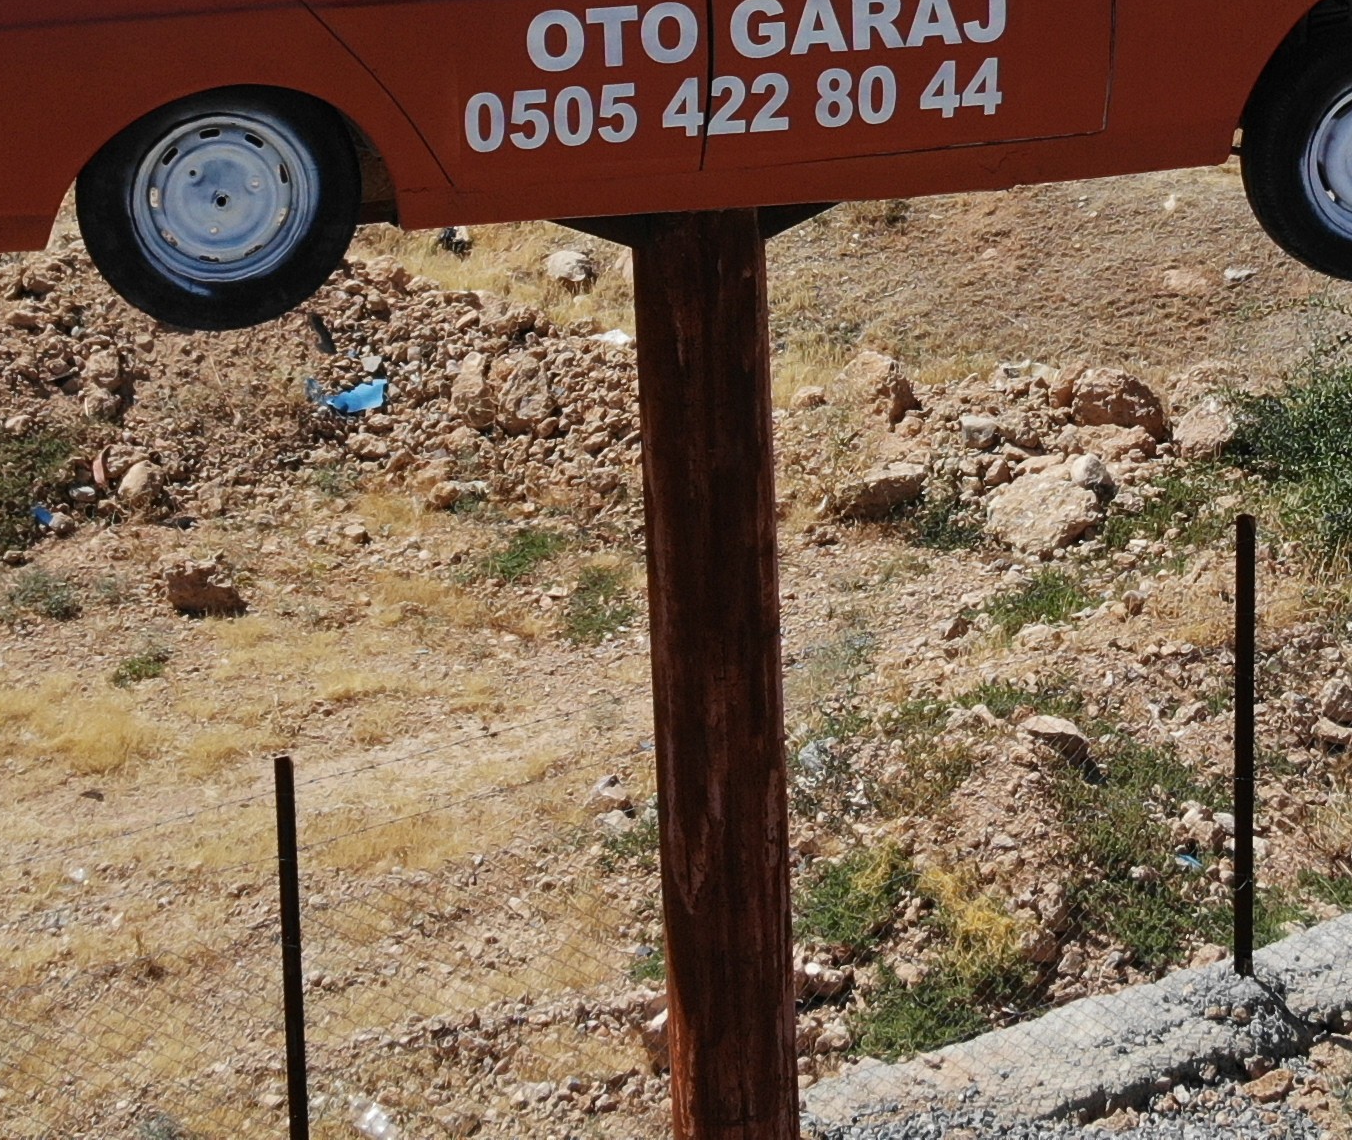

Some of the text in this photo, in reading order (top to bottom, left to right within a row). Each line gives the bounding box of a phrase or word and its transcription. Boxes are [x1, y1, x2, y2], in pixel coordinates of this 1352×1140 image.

[526, 1, 699, 72] OTO
[464, 57, 1003, 153] 0505 422 80 44
